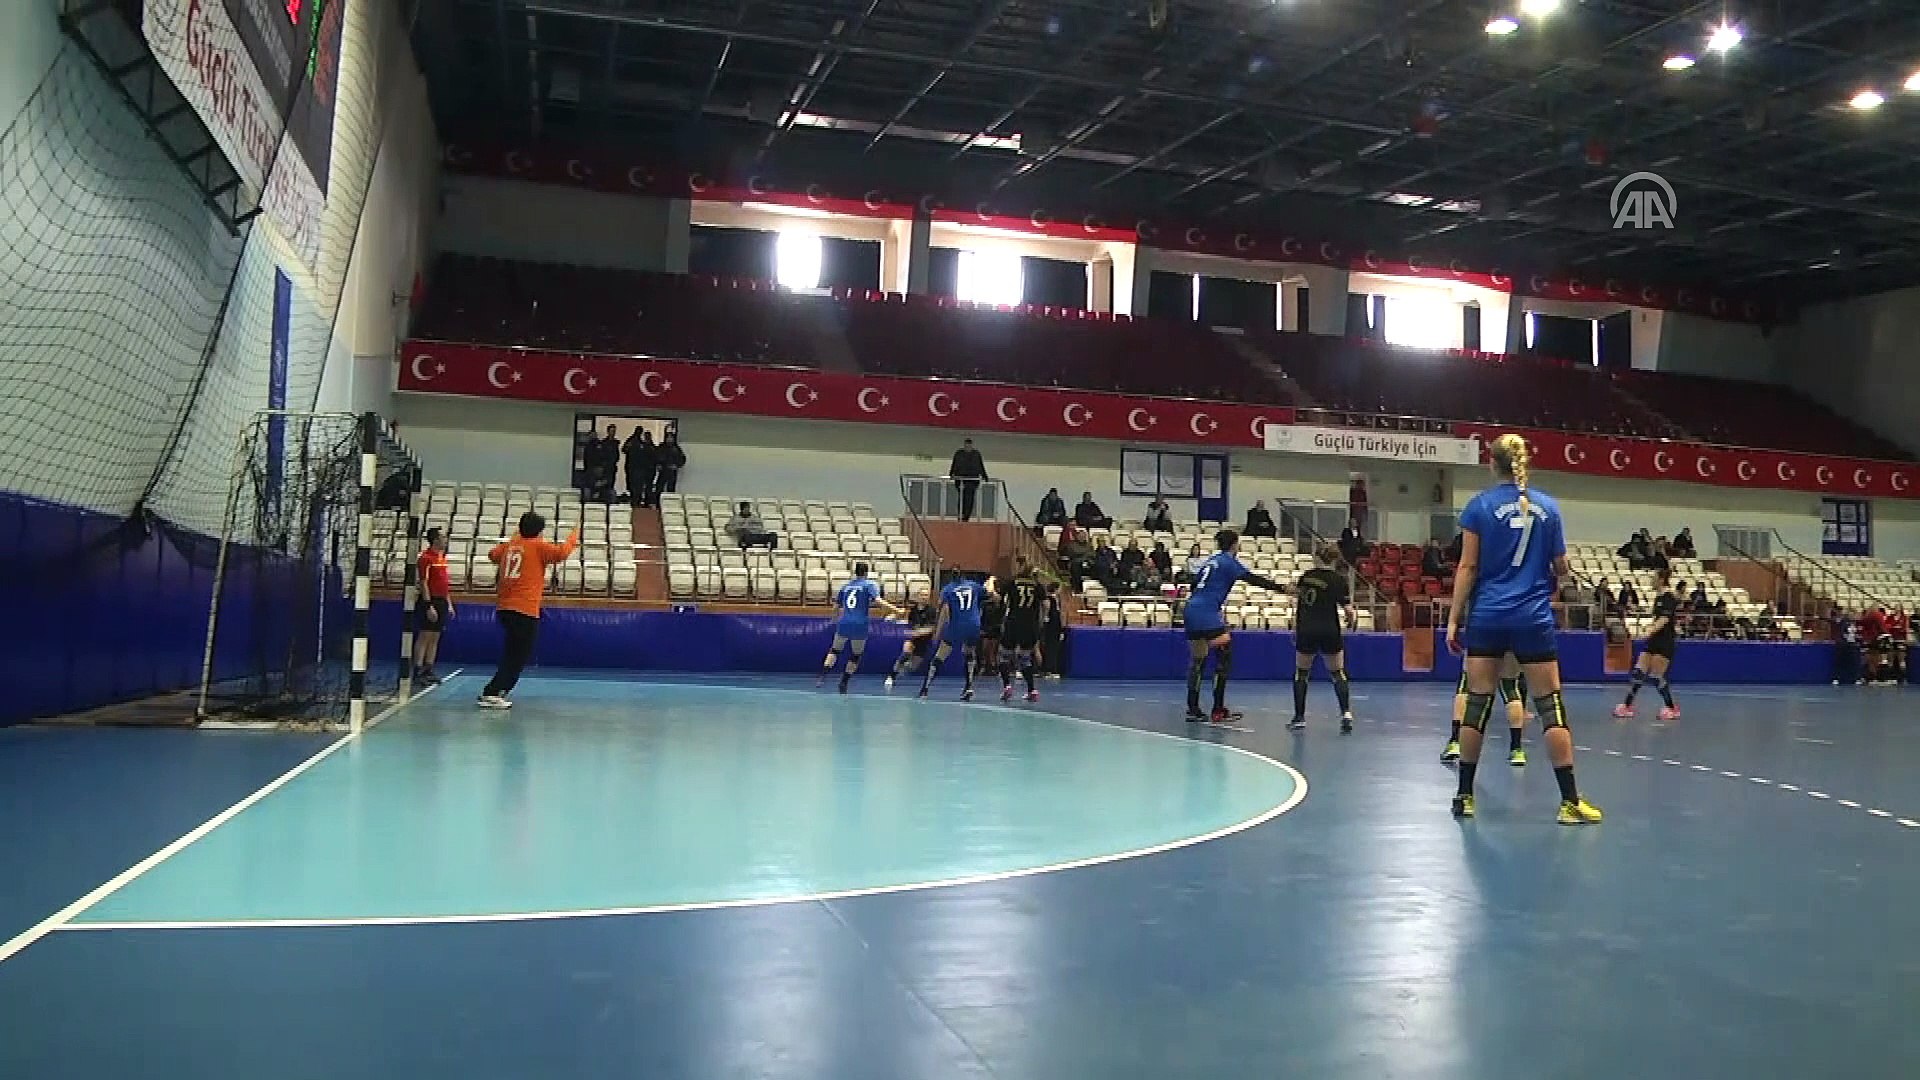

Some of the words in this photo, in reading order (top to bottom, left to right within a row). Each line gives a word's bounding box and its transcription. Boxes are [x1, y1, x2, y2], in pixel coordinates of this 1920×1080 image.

[1314, 433, 1354, 452] Güçlü
[1358, 437, 1410, 457] Türkiye
[1412, 437, 1437, 459] İçin
[1509, 515, 1535, 567] 7
[503, 552, 522, 579] 12
[846, 590, 857, 609] 6
[955, 590, 973, 611] 17
